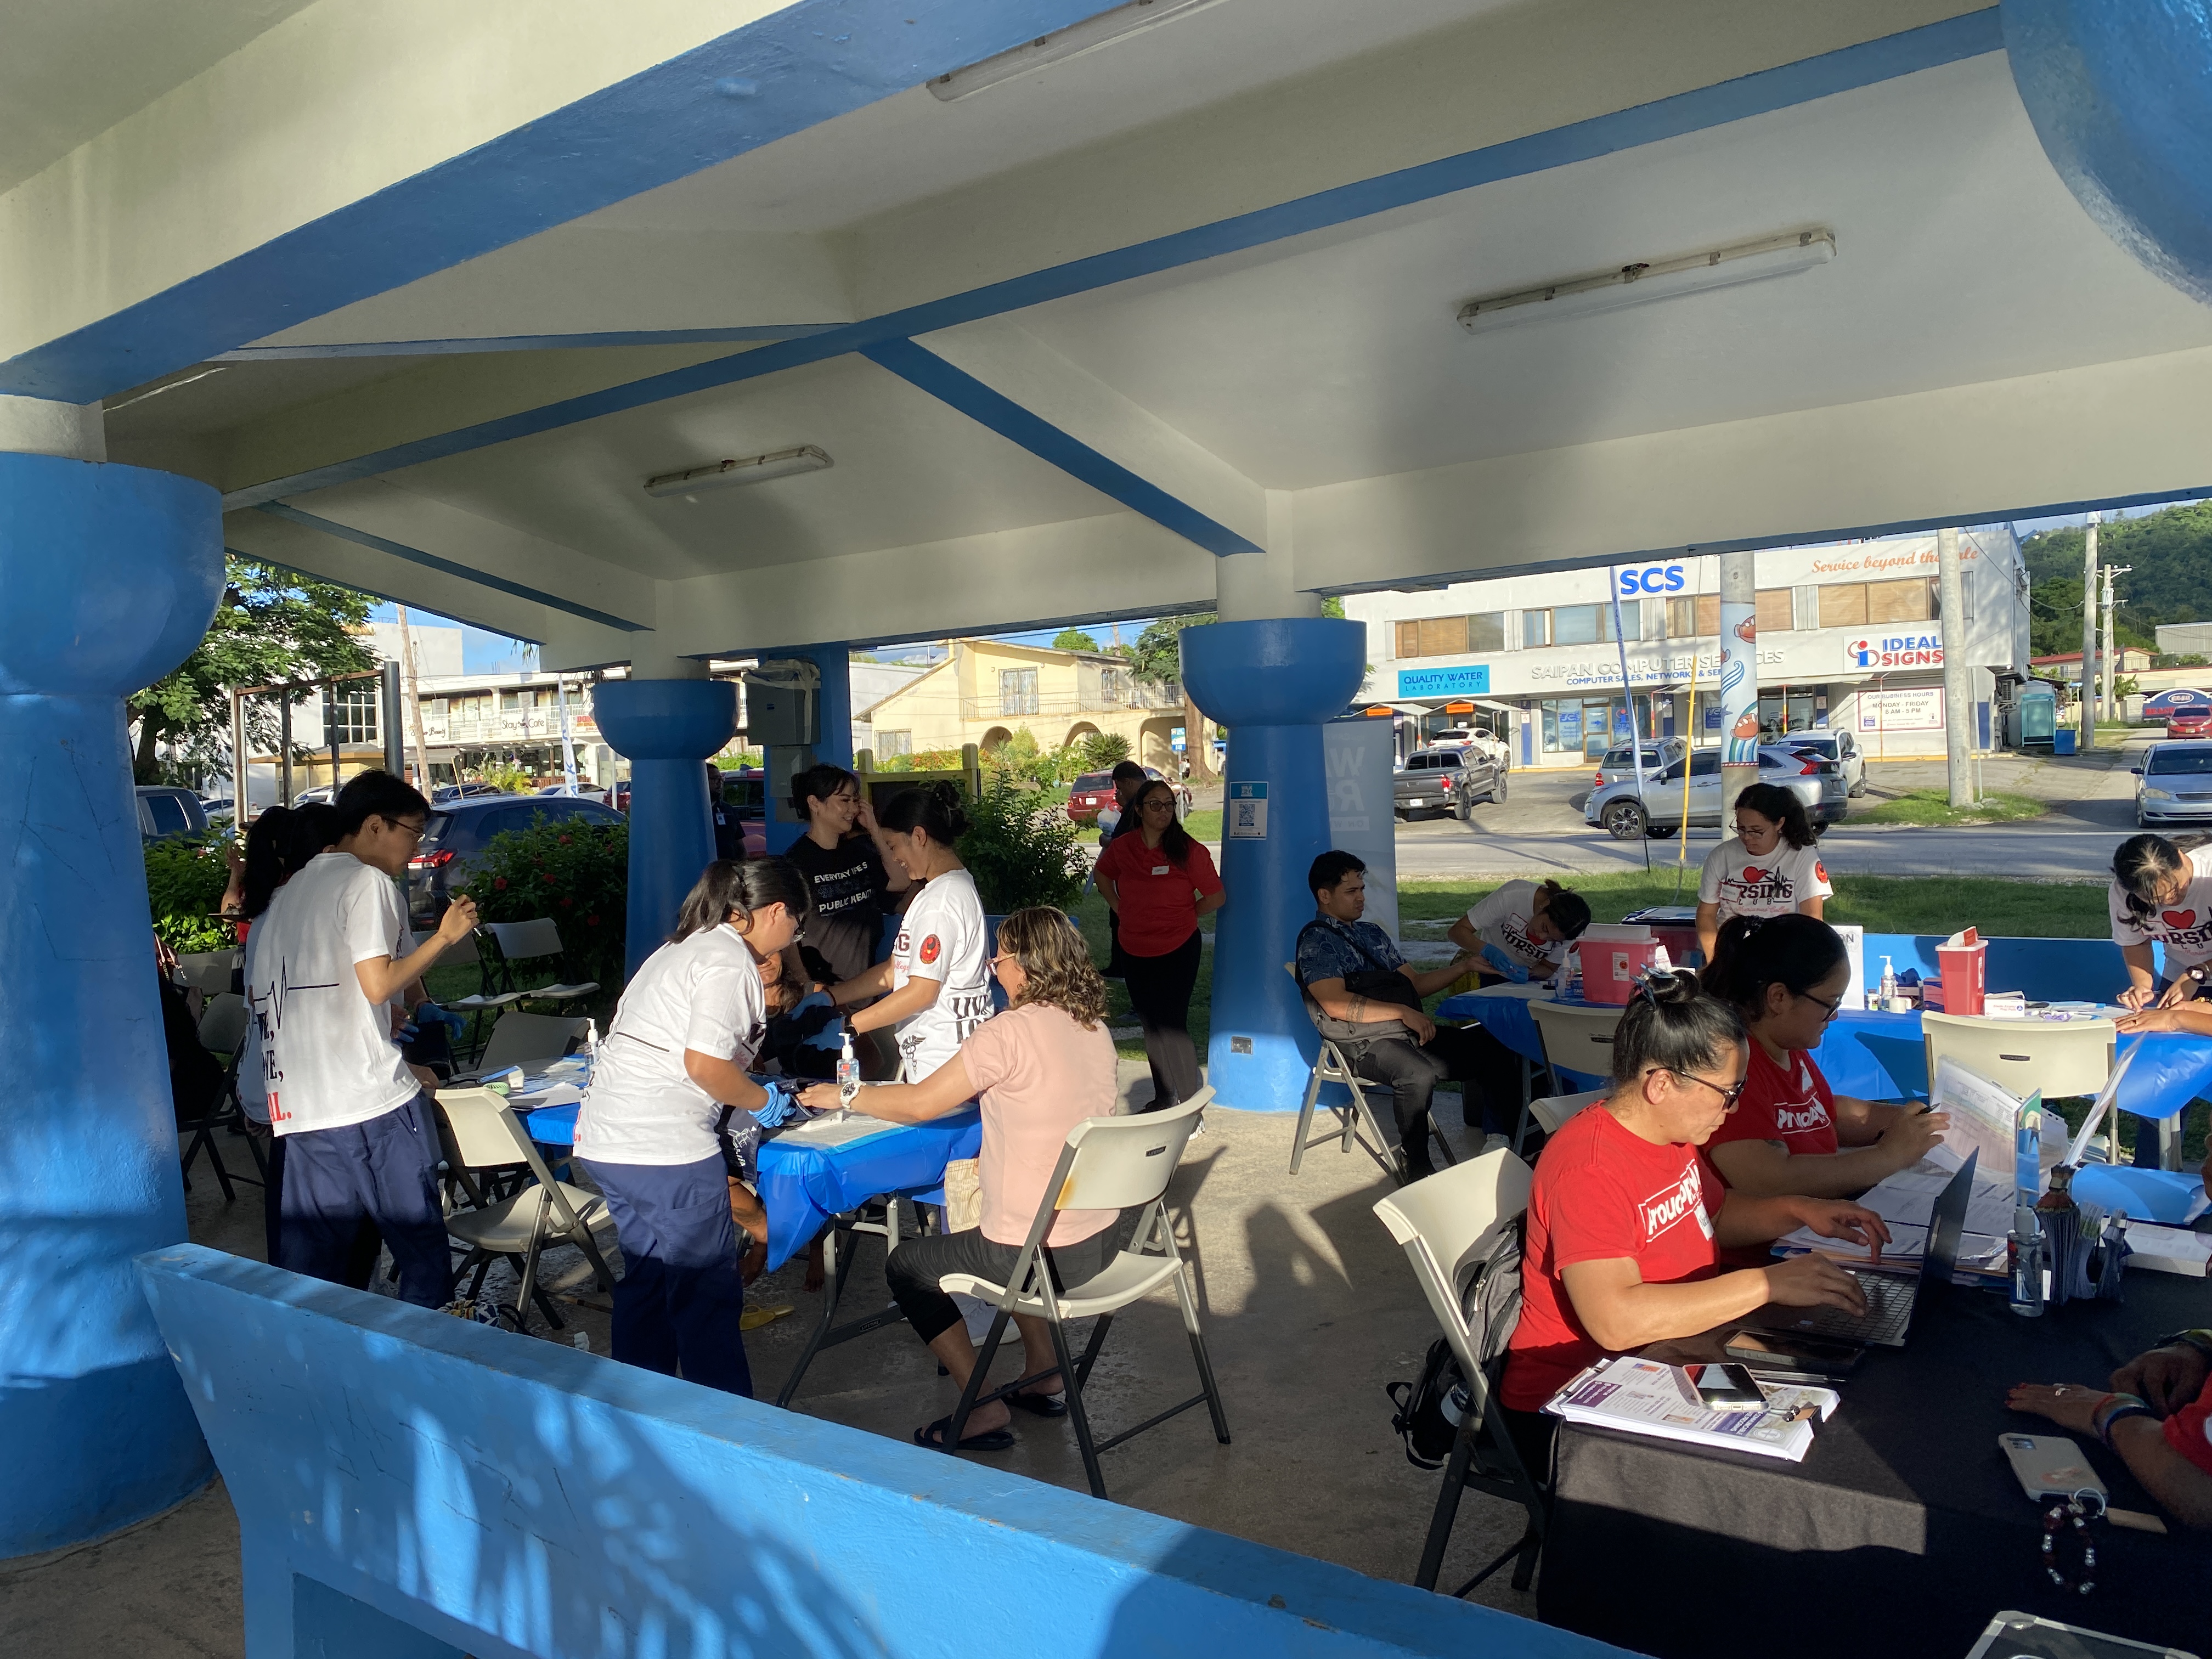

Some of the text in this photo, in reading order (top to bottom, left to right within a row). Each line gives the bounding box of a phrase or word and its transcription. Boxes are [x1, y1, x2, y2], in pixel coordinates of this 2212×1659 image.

[1812, 559, 1860, 573] Service
[1864, 551, 1916, 572] beyond
[1620, 565, 1685, 595] SCS
[1882, 635, 1942, 652] IDEAL
[1881, 650, 1944, 667] SIGNS
[1403, 672, 1483, 684] QUALITY WATER
[1532, 662, 1594, 680] SAIPAN
[1406, 681, 1481, 691] LABORATORY
[1566, 676, 1613, 686] COMPUTER
[502, 718, 545, 730] Stay Cafe
